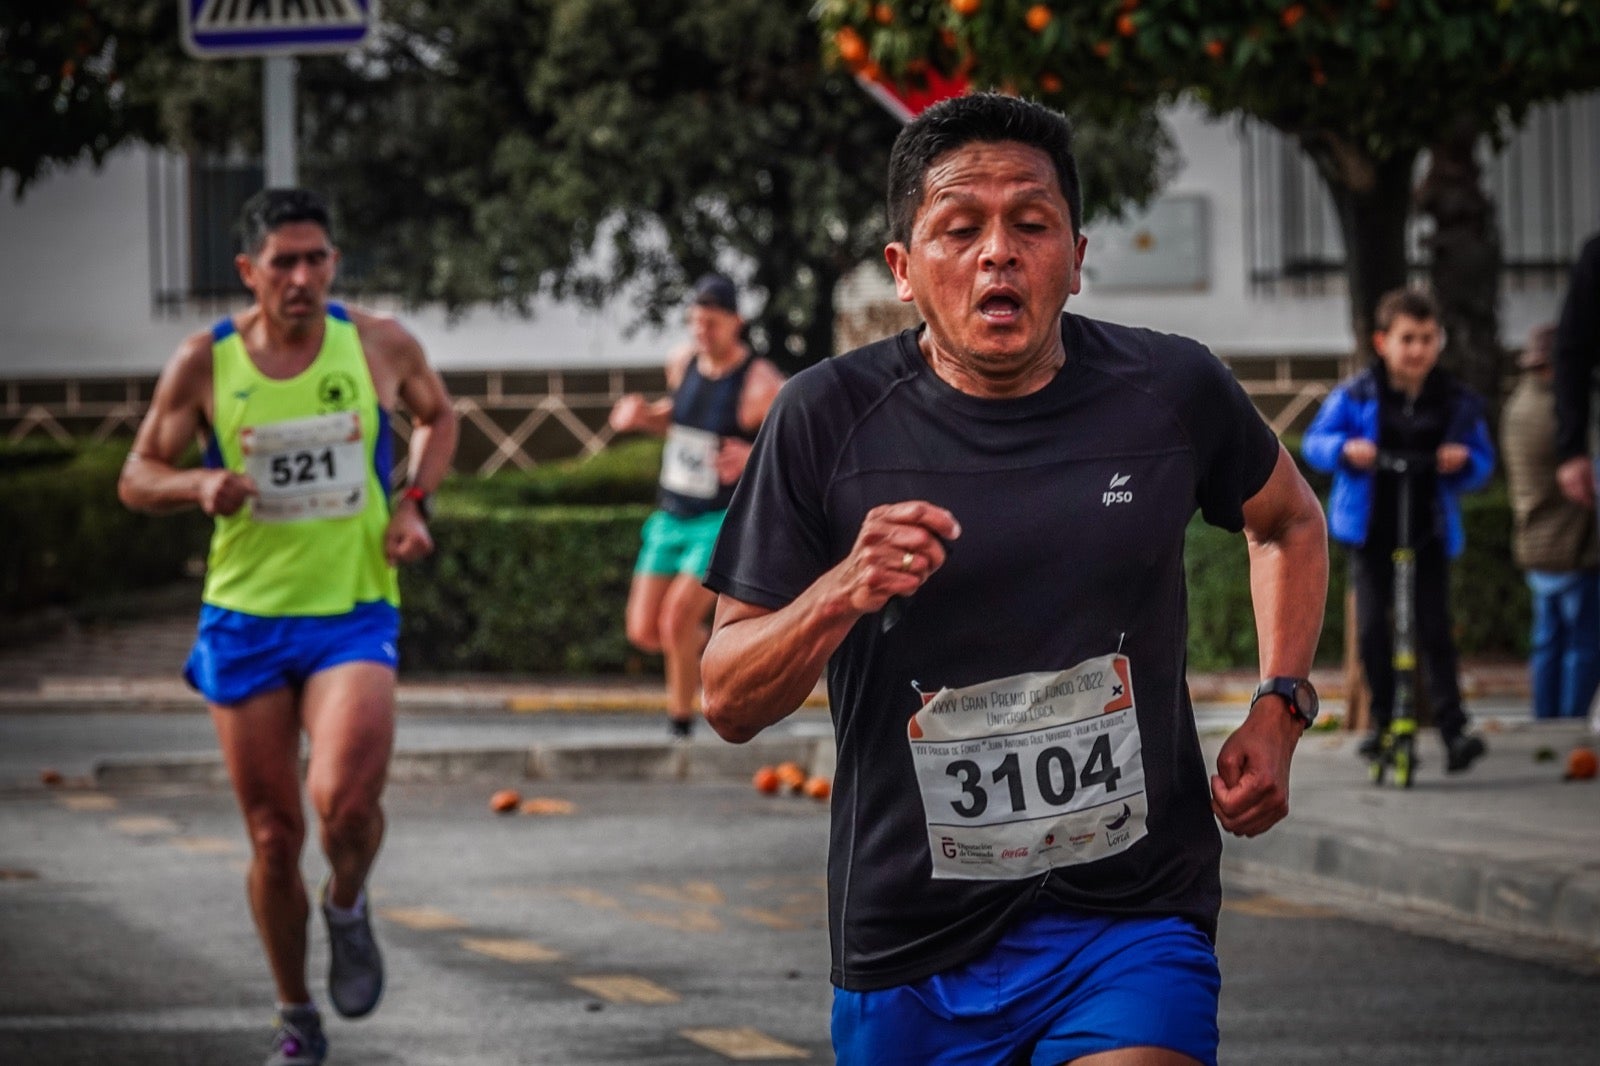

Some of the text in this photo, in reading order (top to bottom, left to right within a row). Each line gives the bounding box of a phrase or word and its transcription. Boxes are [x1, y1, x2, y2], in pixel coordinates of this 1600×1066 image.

[271, 448, 336, 486] 521
[1102, 491, 1133, 507] ipso
[961, 695, 988, 712] GRAN
[990, 691, 1026, 708] PREMIO
[1030, 690, 1041, 704] DE
[1044, 681, 1075, 701] FONDO
[1076, 671, 1104, 693] 2022
[986, 704, 1056, 726] UNIVERSO LORCA
[945, 733, 1122, 818] 3104
